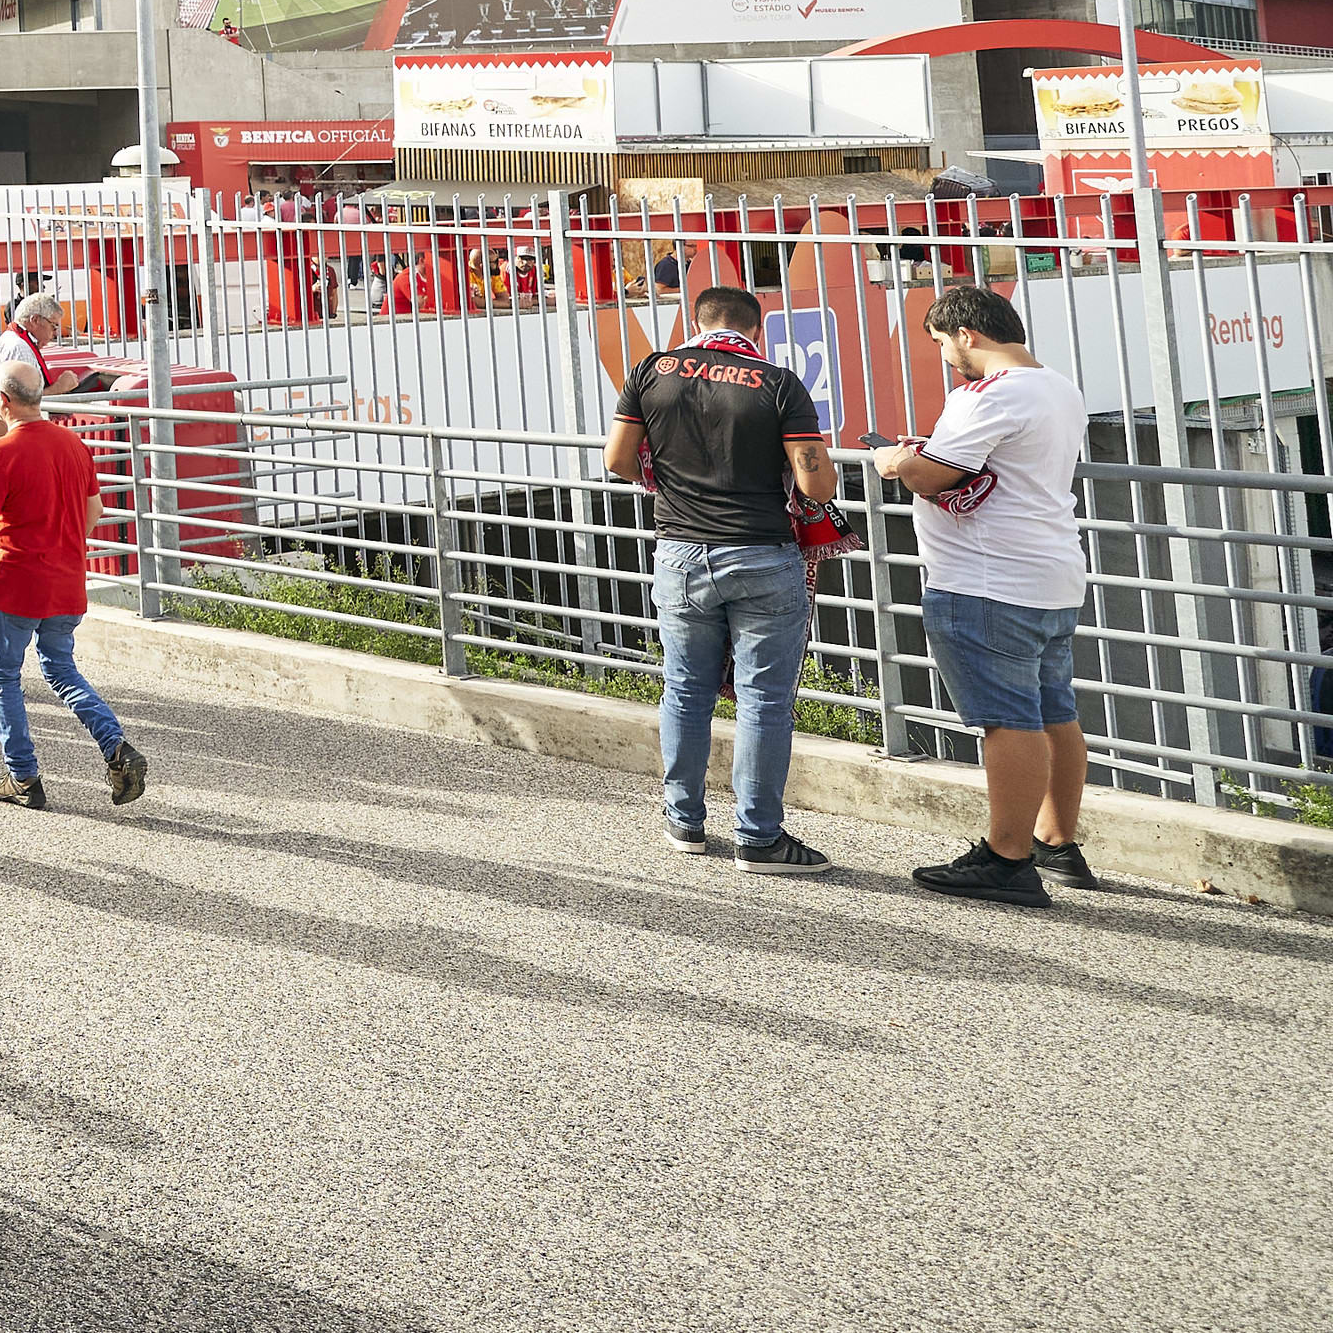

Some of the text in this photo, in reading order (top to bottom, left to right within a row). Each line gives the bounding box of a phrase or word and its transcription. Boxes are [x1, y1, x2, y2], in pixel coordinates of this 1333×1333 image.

[754, 3, 791, 12] ESTÁDIO
[421, 122, 583, 139] BIFANAS ENTREMEADA
[1065, 118, 1239, 135] BIFANAS PREGOS
[241, 130, 391, 144] BENFICA OFFICIAL
[1208, 311, 1284, 349] Rentng
[679, 357, 764, 390] SAGRES
